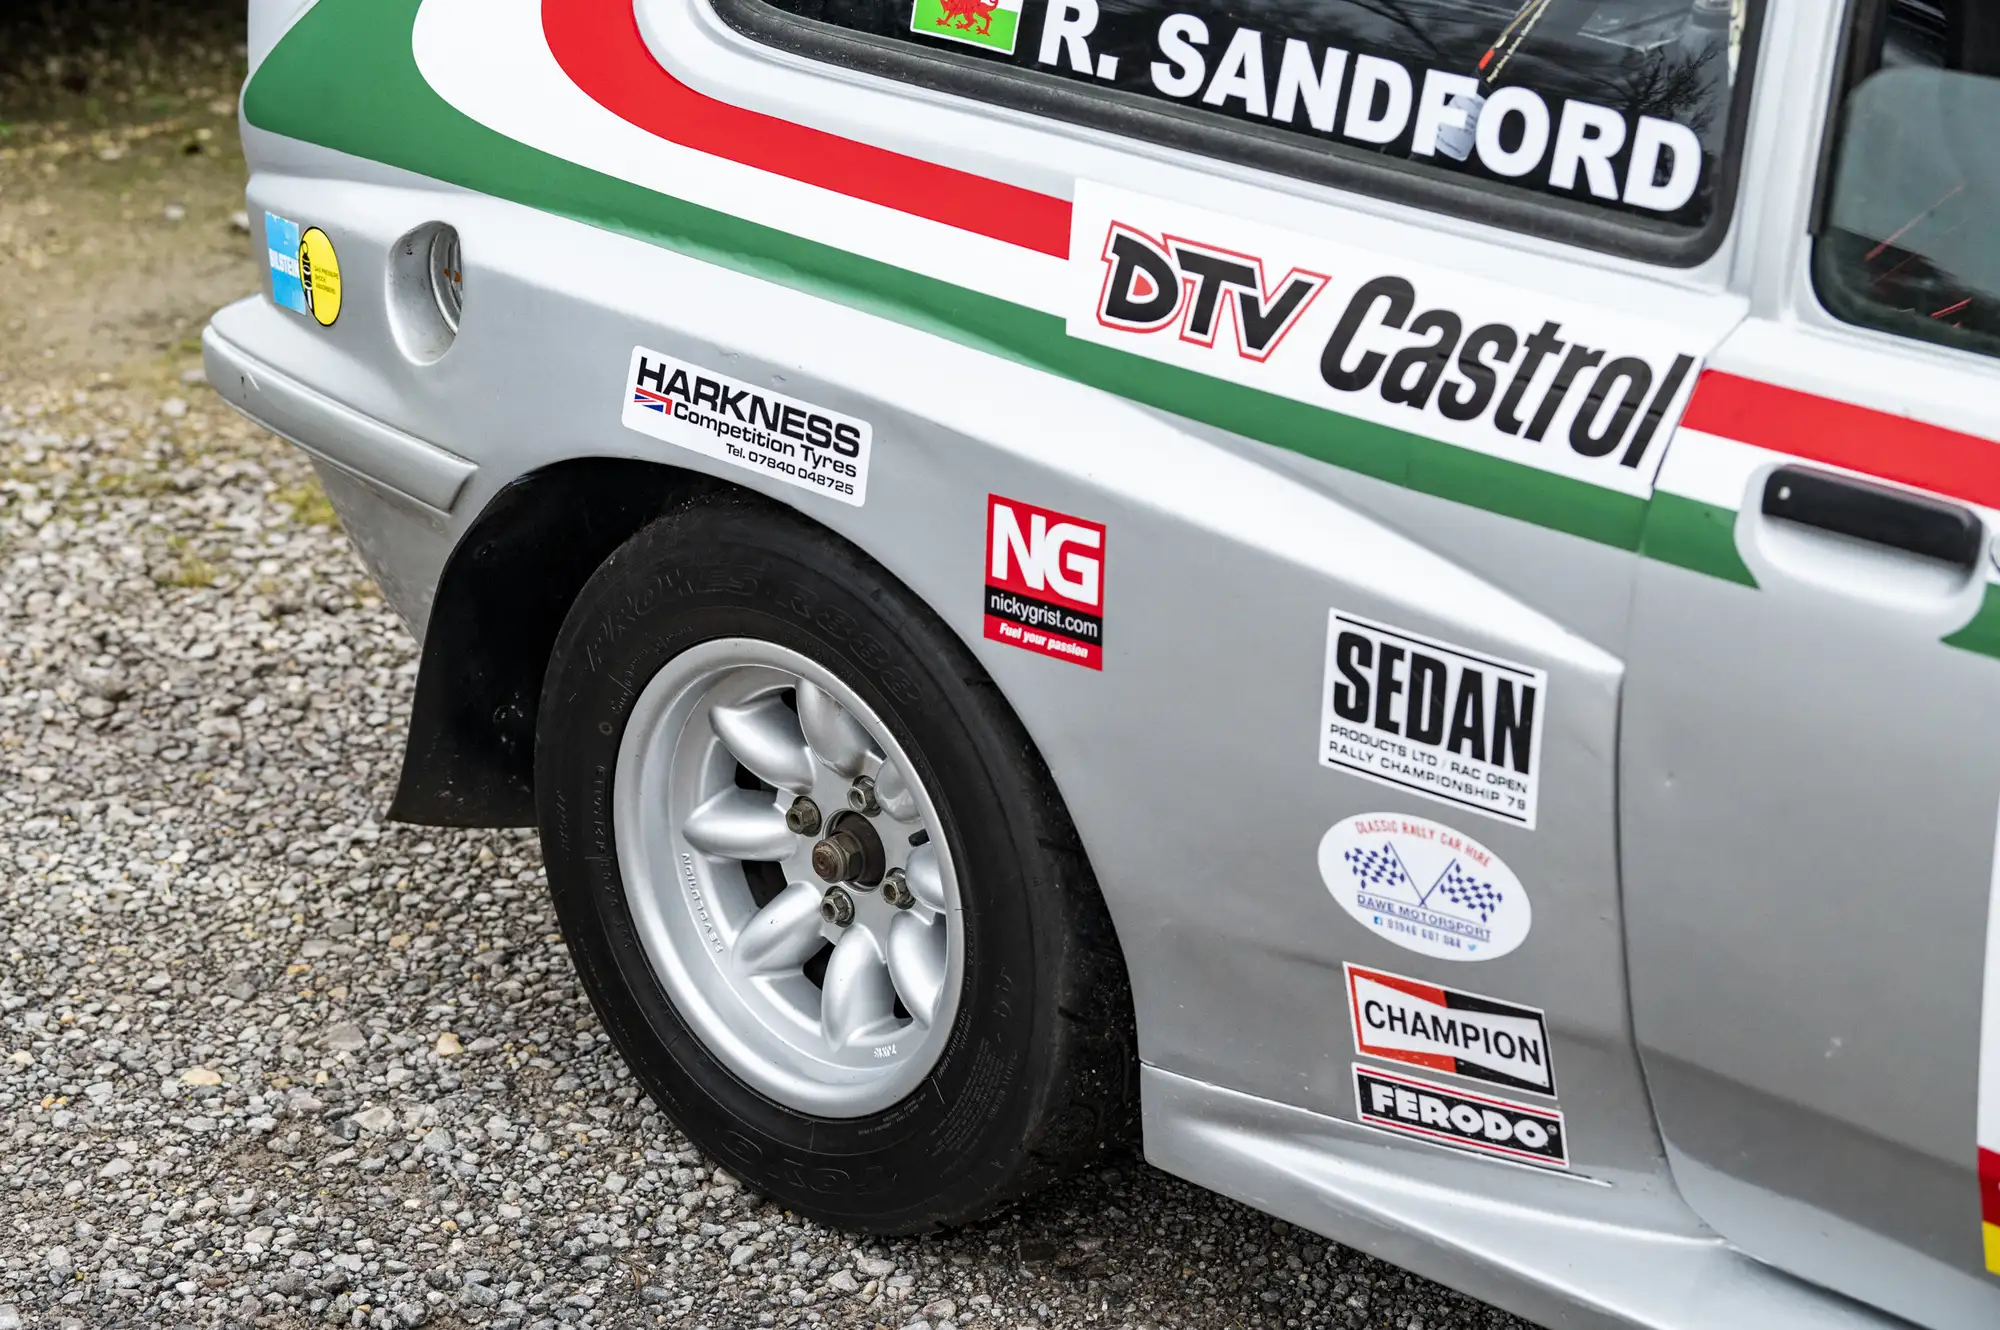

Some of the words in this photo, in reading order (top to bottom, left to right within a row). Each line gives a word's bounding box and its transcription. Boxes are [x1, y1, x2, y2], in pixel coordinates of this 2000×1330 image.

[1039, 0, 1120, 79] R.
[1150, 13, 1702, 212] SANDFORD
[1097, 220, 1332, 362] DTV
[637, 356, 860, 458] HARKNESS
[1320, 276, 1697, 469] Castrol
[674, 402, 795, 458] Competition
[802, 445, 857, 478] Tyres
[726, 444, 746, 459] Tel.
[749, 452, 795, 475] 07840
[798, 470, 854, 495] 048725
[992, 503, 1100, 606] NG
[991, 593, 1098, 637] nickygrist.com
[1000, 622, 1022, 639] Fuel
[1023, 631, 1047, 646] your
[1047, 638, 1088, 659] passion
[1333, 631, 1536, 775] SEDAN
[1330, 723, 1407, 758] PRODUCTS
[1412, 749, 1438, 768] LTD
[1451, 761, 1481, 781] RAC
[1487, 771, 1528, 794] OPEN
[1330, 740, 1374, 764] RALLY
[1380, 757, 1501, 802] CHAMPIONSHIP
[1355, 820, 1399, 835] CLASSIC
[1402, 822, 1436, 841] RALLY
[1440, 833, 1461, 851] CAR
[1466, 844, 1492, 867] HIRE
[682, 852, 723, 954] REVOLUTION
[1357, 893, 1395, 914] DAWE
[1399, 906, 1491, 940] MOTORSPORT
[1365, 1000, 1541, 1066] CHAMPION
